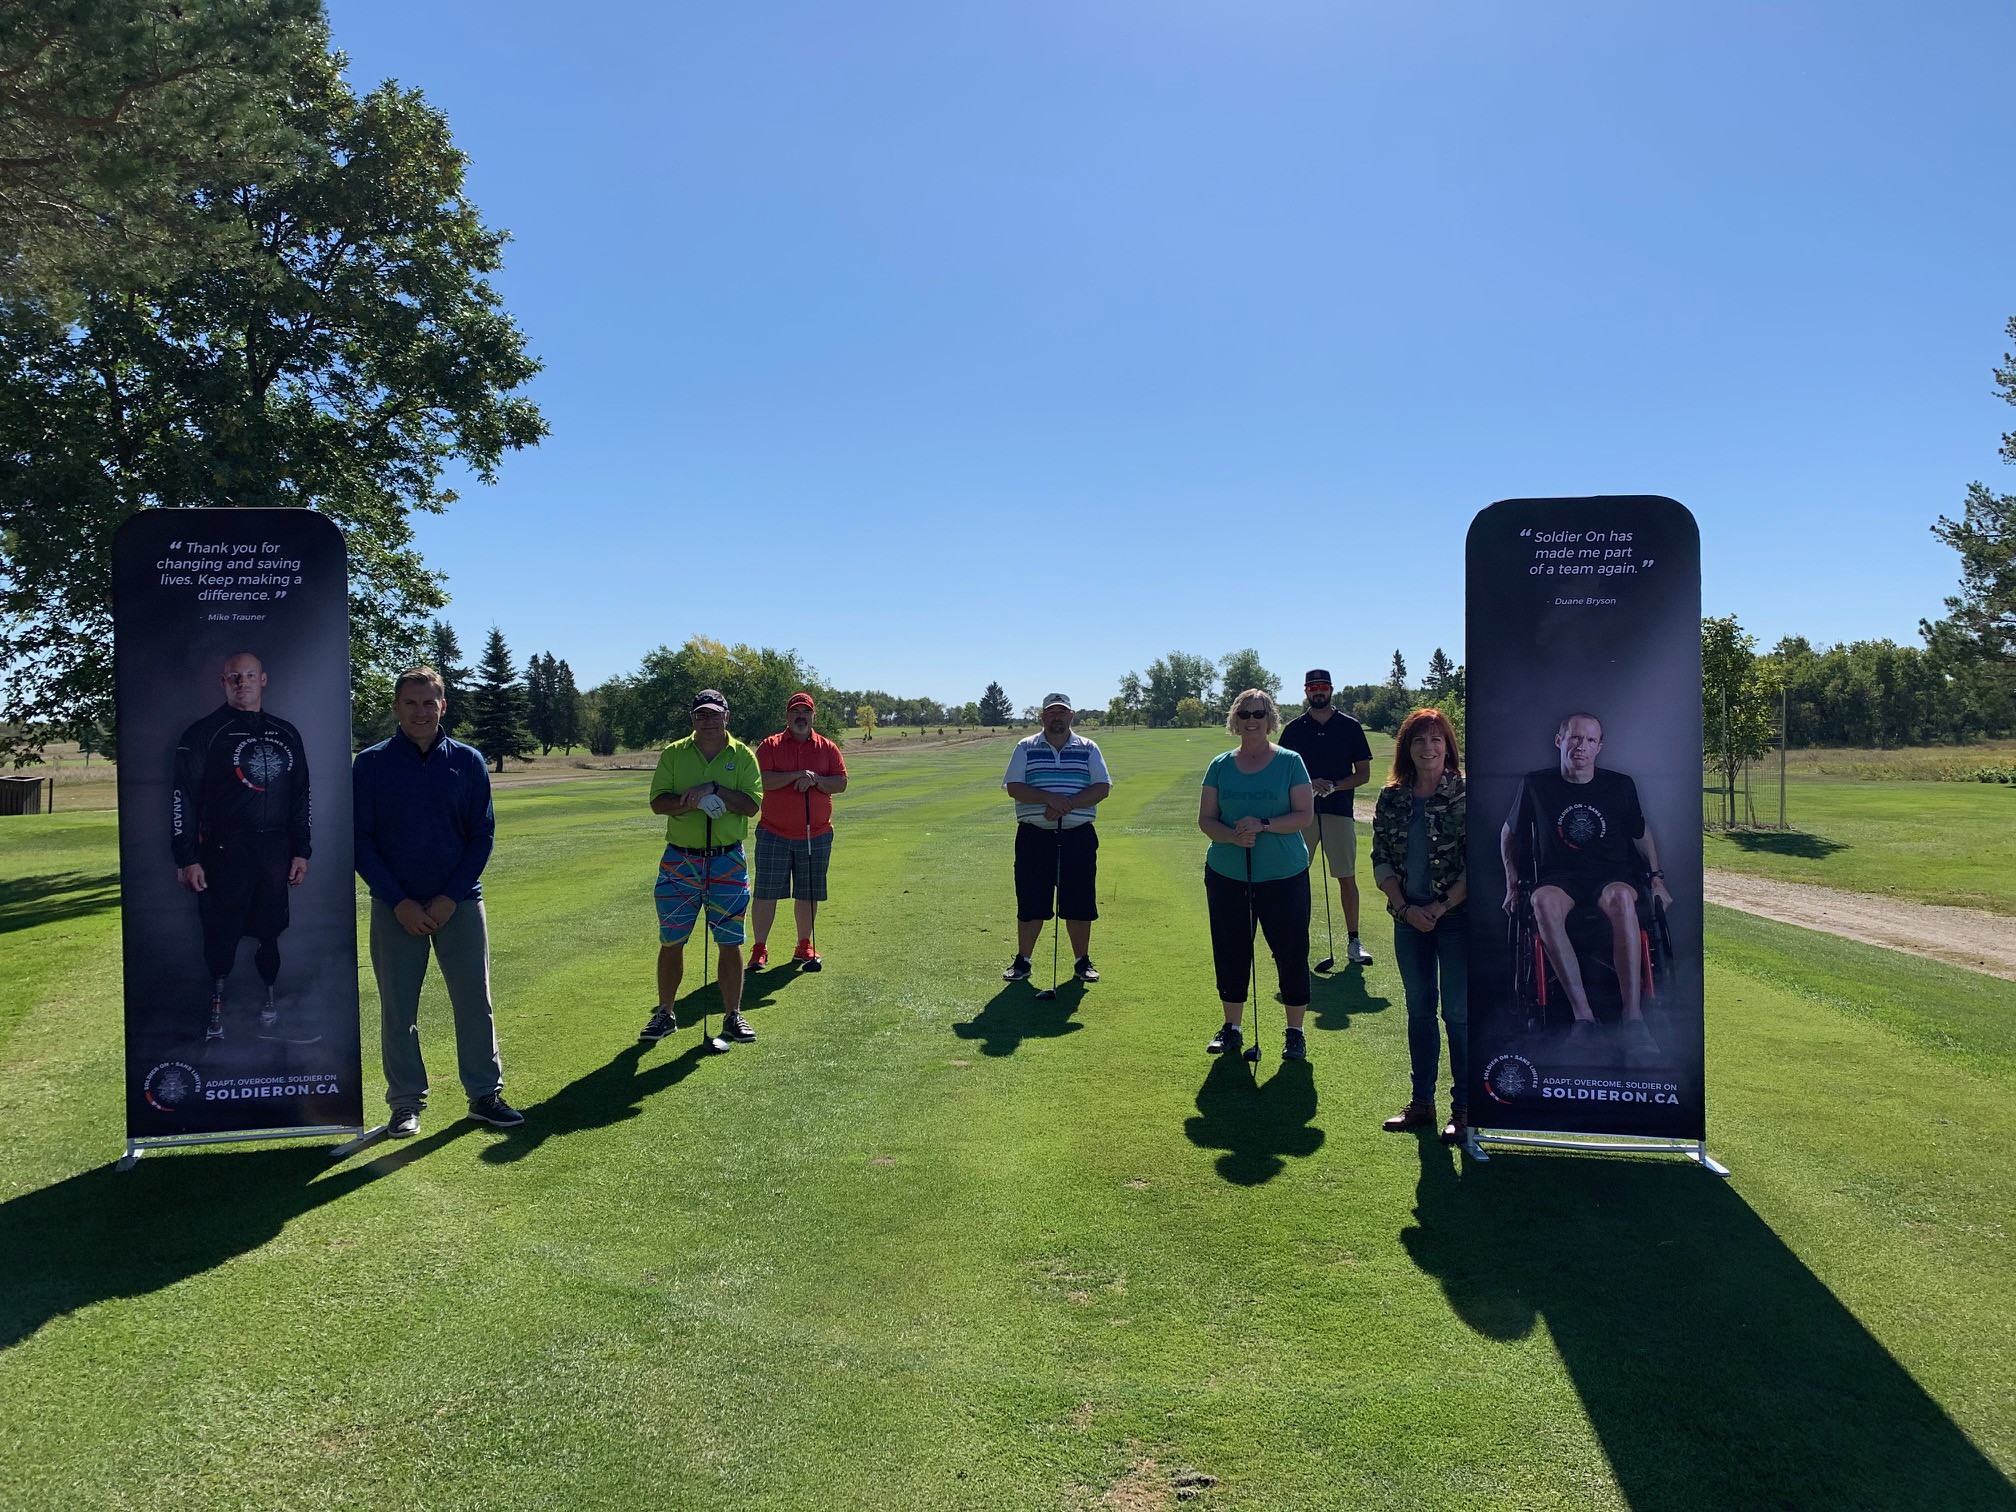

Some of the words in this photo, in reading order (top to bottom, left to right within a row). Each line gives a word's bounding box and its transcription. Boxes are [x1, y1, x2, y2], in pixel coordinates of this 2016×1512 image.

[1534, 531, 1582, 543] Soldier
[1585, 531, 1605, 542] On
[1609, 530, 1633, 542] has
[186, 542, 227, 553] Thank
[231, 544, 256, 555] you
[261, 542, 280, 553] for
[1535, 547, 1574, 558] made
[1578, 550, 1600, 558] me
[1604, 547, 1633, 560] part
[156, 558, 222, 571] changing
[227, 558, 253, 569] and
[257, 558, 300, 571] saving
[1529, 564, 1544, 575] of
[1546, 565, 1554, 575] a
[1559, 564, 1593, 574] team
[1598, 563, 1638, 576] again.
[160, 574, 193, 585] lives.
[198, 574, 234, 586] Keep
[238, 574, 290, 586] making
[294, 576, 302, 585] a
[198, 590, 270, 601] difference.
[1586, 598, 1616, 607] Bryson
[233, 741, 247, 765] SOLDIER
[174, 790, 182, 835] CANADA
[1558, 806, 1573, 825] SOLDIER
[1484, 1058, 1499, 1080] SOLDIER
[1515, 1055, 1530, 1065] SANS
[144, 1067, 159, 1090] SOLDIER
[175, 1062, 192, 1071] SANS
[206, 1079, 235, 1087] ADAPT.
[288, 1075, 323, 1083] SOLDIER
[1574, 1079, 1623, 1088] OVERCOME.
[1625, 1082, 1661, 1090] SOLDIER
[205, 1083, 339, 1100] SOLDIERON.CA
[1542, 1087, 1679, 1104] SOLDIERON.CA
